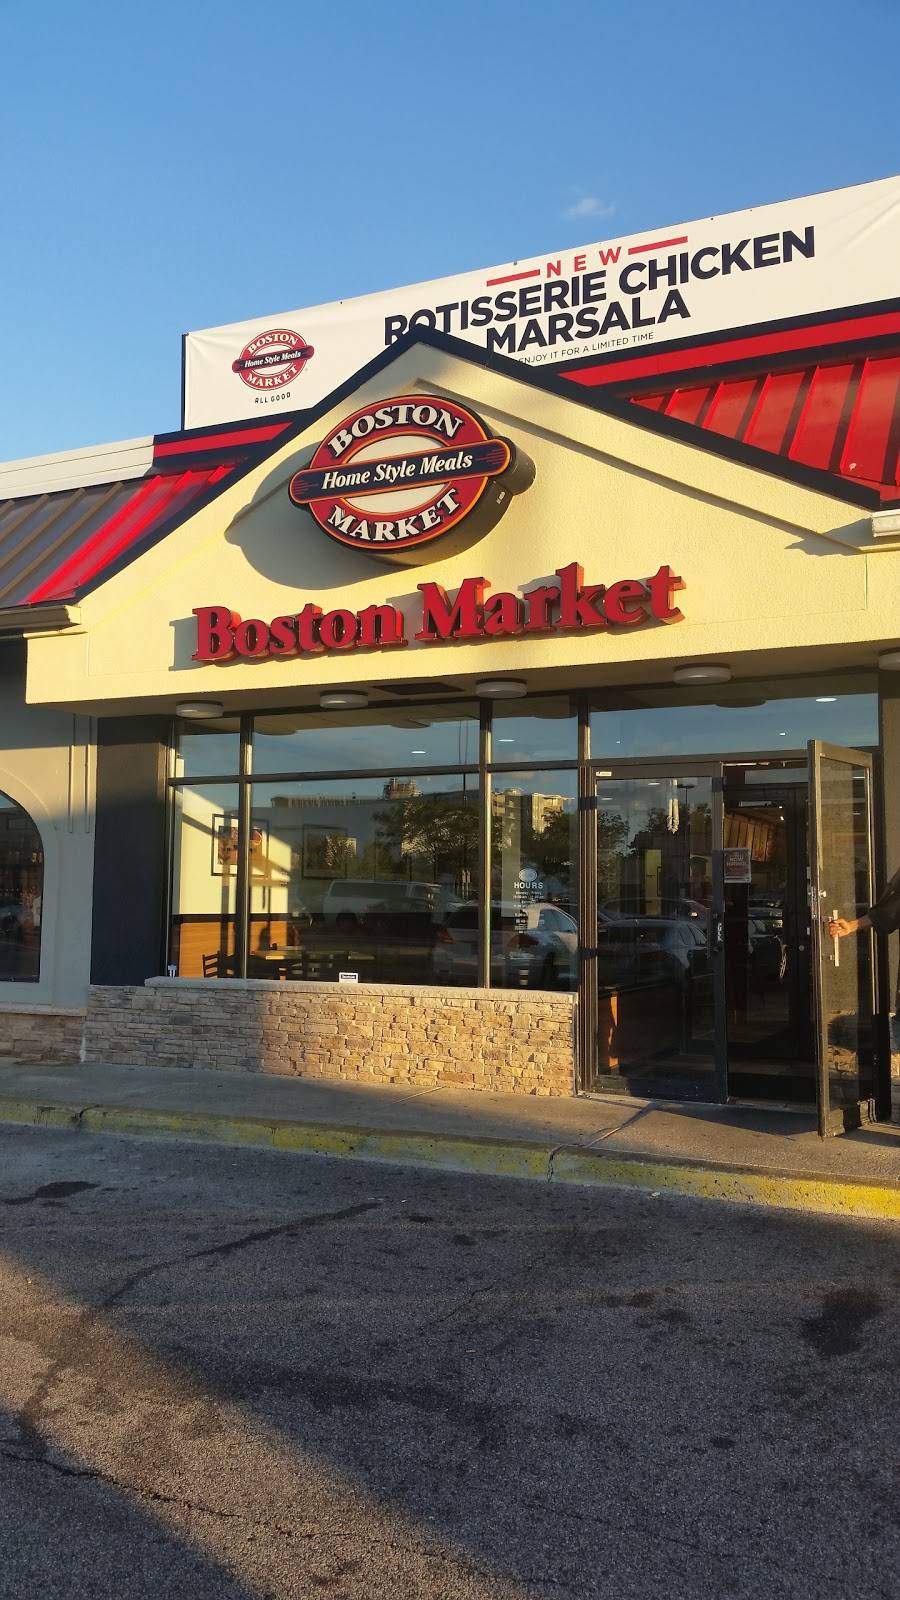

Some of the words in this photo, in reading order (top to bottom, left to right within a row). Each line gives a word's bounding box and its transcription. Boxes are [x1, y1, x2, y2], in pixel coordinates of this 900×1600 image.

[547, 246, 622, 278] NEW
[384, 269, 607, 346] ROTISSERIE
[618, 225, 815, 295] CHICKEN
[486, 288, 691, 354] MARSALA
[244, 359, 263, 368] Home
[264, 355, 280, 364] Style
[281, 350, 301, 361] Meals
[247, 333, 299, 354] BOSTON
[561, 347, 580, 357] FOR
[583, 345, 590, 353] A
[591, 337, 629, 351] LIMITED
[632, 331, 654, 343] TIME
[246, 365, 298, 387] MARKET
[270, 391, 291, 403] GOOD
[327, 403, 463, 458] BOSTON
[321, 471, 371, 490] Home
[373, 458, 416, 484] Style
[418, 450, 474, 476] Meals
[327, 488, 461, 542] MARKET
[191, 602, 408, 662] Boston
[414, 561, 686, 641] Market
[513, 881, 544, 889] HOURS
